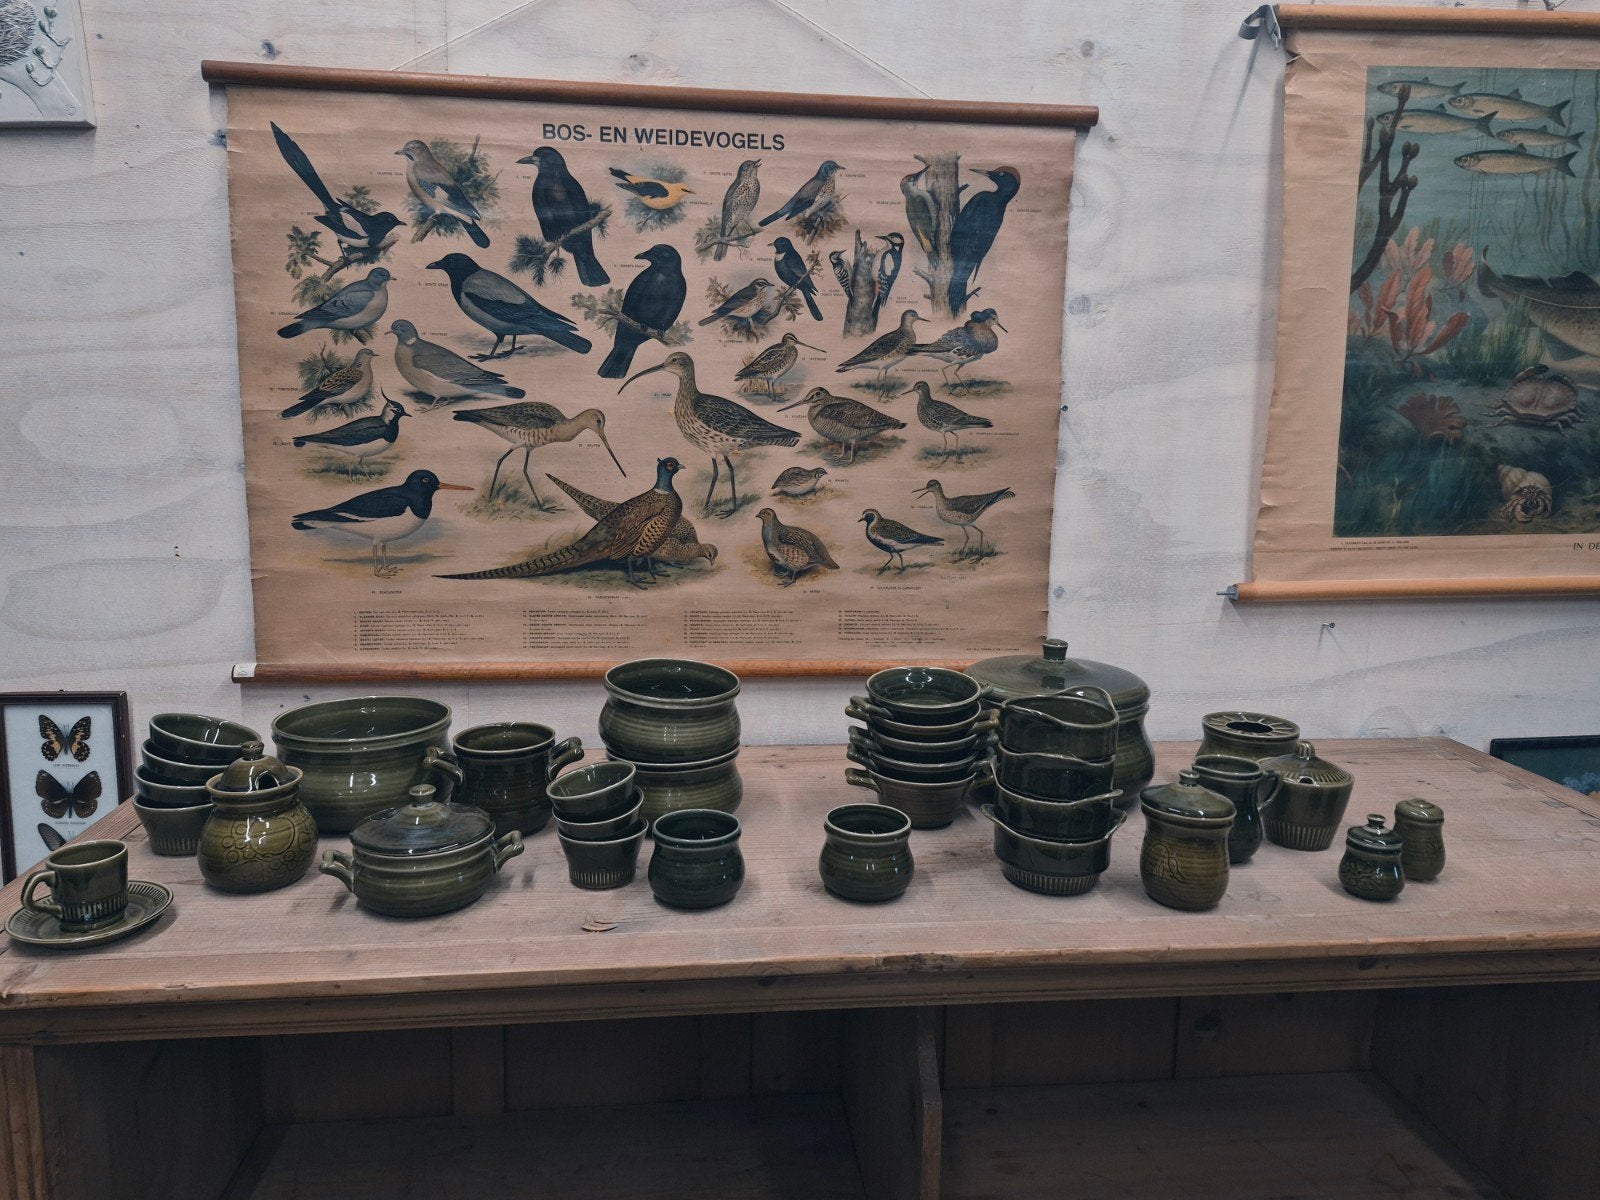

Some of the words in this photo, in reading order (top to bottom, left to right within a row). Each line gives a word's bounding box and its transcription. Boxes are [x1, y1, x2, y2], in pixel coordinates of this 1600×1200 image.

[542, 123, 592, 141] BOS-
[600, 126, 627, 143] EN
[634, 127, 785, 150] WEIDEVOGELS
[1573, 542, 1584, 550] IN
